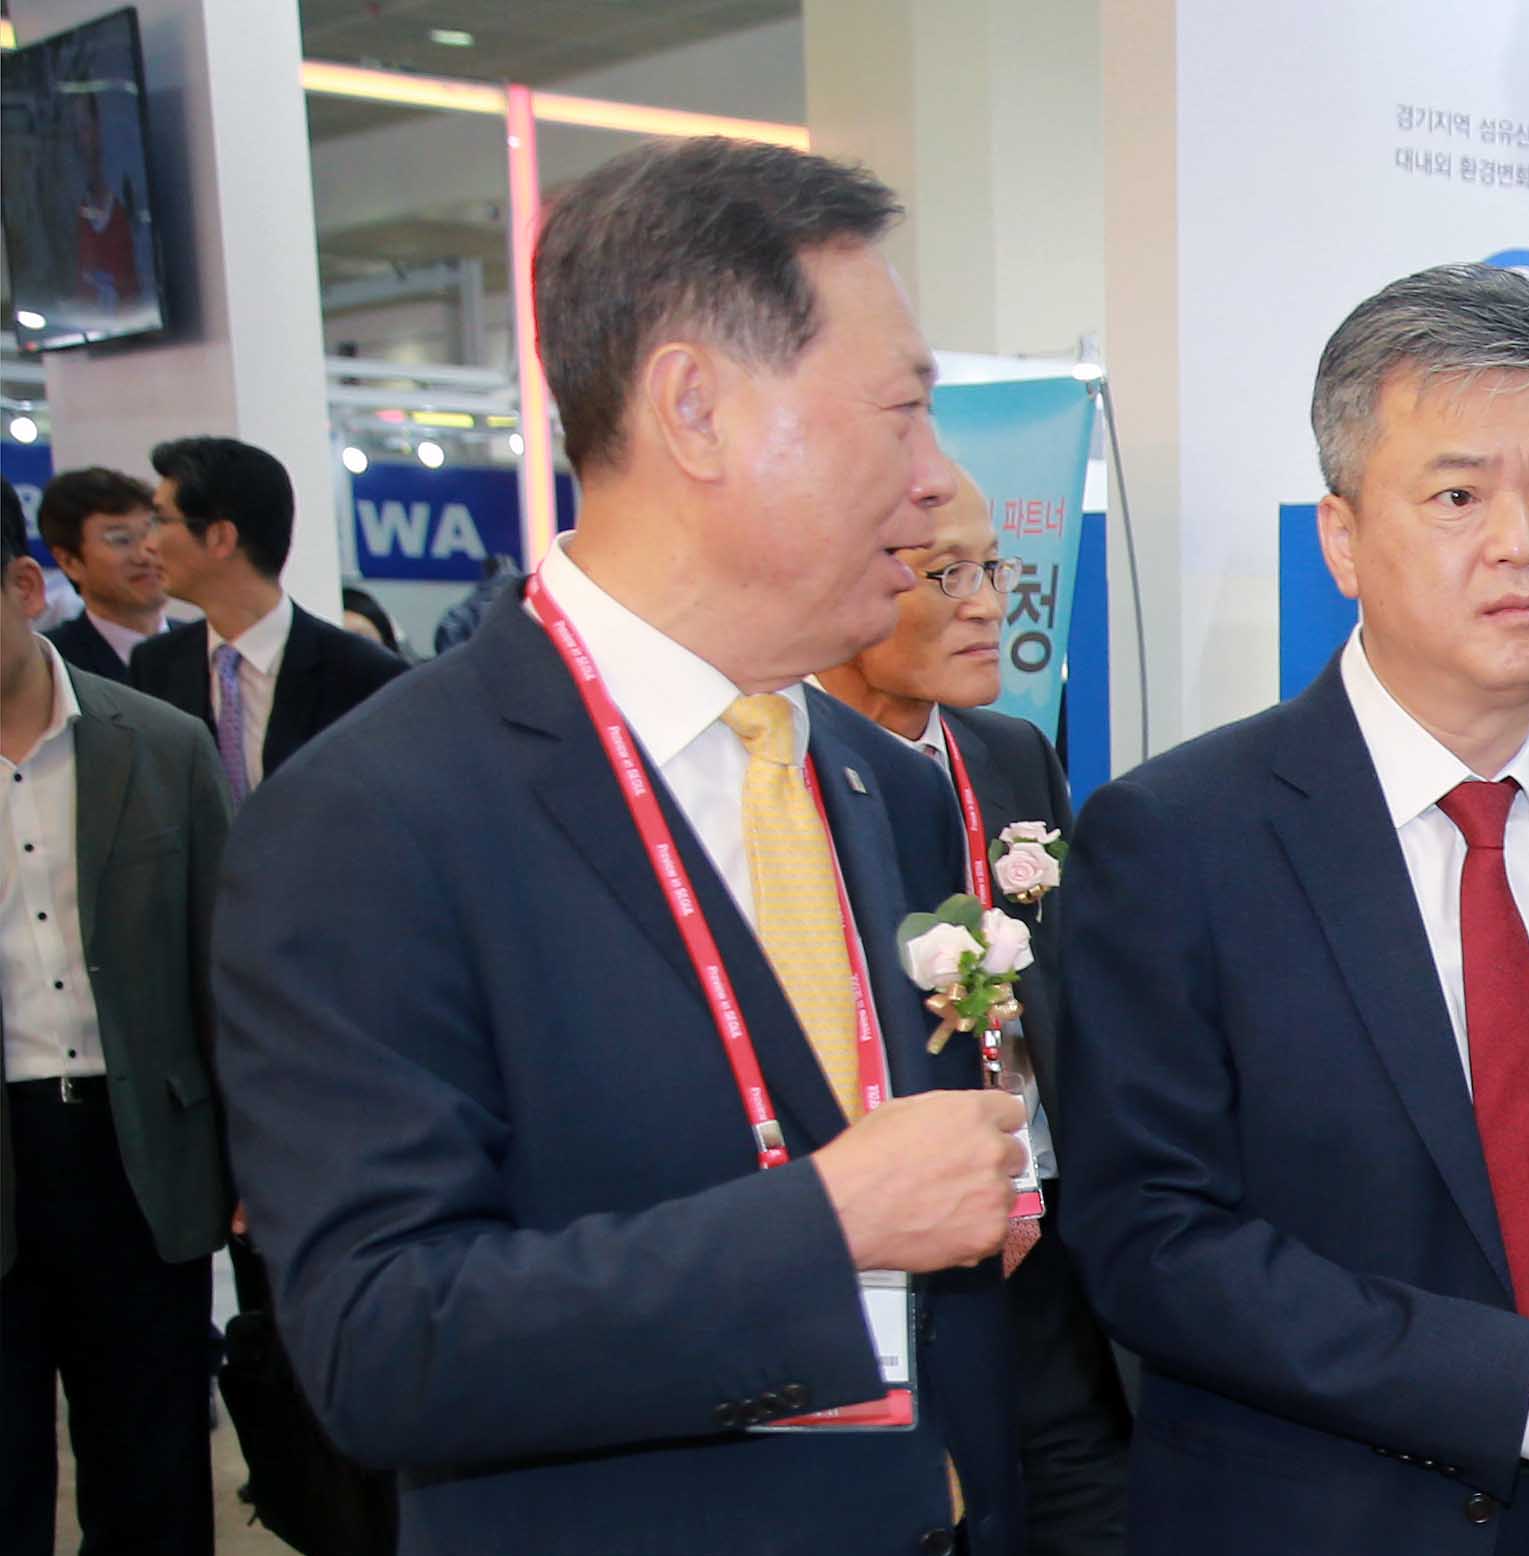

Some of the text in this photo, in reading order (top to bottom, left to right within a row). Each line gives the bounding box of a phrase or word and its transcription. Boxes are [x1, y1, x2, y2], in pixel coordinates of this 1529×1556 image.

[1395, 102, 1472, 139] 경기지역
[1394, 146, 1453, 181] 대내외
[356, 498, 489, 562] WA
[1002, 496, 1066, 540] 파트너
